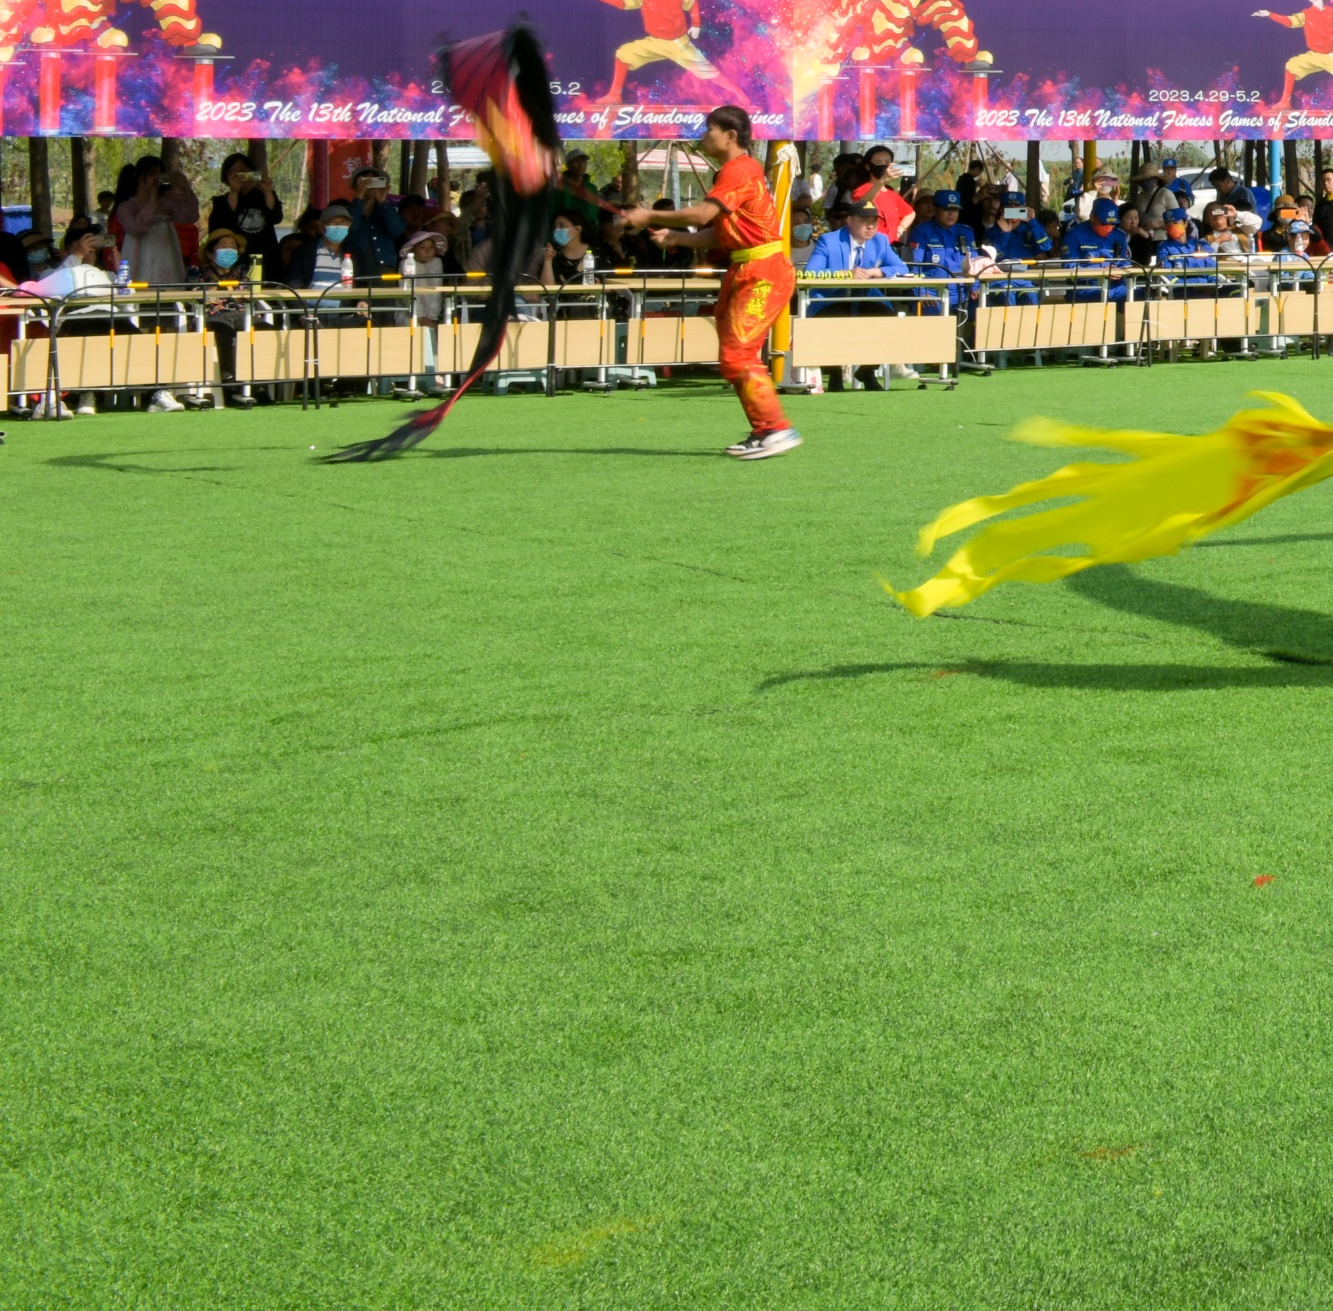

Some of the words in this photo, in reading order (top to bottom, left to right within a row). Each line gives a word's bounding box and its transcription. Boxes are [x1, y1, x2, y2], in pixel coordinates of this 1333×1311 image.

[1148, 89, 1261, 103] 2023.4.29-5.2
[195, 101, 256, 122] 2023
[263, 101, 301, 122] The
[308, 102, 353, 122] 13th
[355, 102, 444, 123] National
[591, 107, 608, 130] of
[615, 106, 705, 130] Shandong
[975, 109, 1020, 127] 2023
[1025, 109, 1053, 127] The
[1058, 109, 1091, 127] 13th
[1094, 109, 1160, 128] National
[1162, 110, 1213, 130] Fitness
[1218, 109, 1264, 132] Games
[1268, 111, 1283, 132] of
